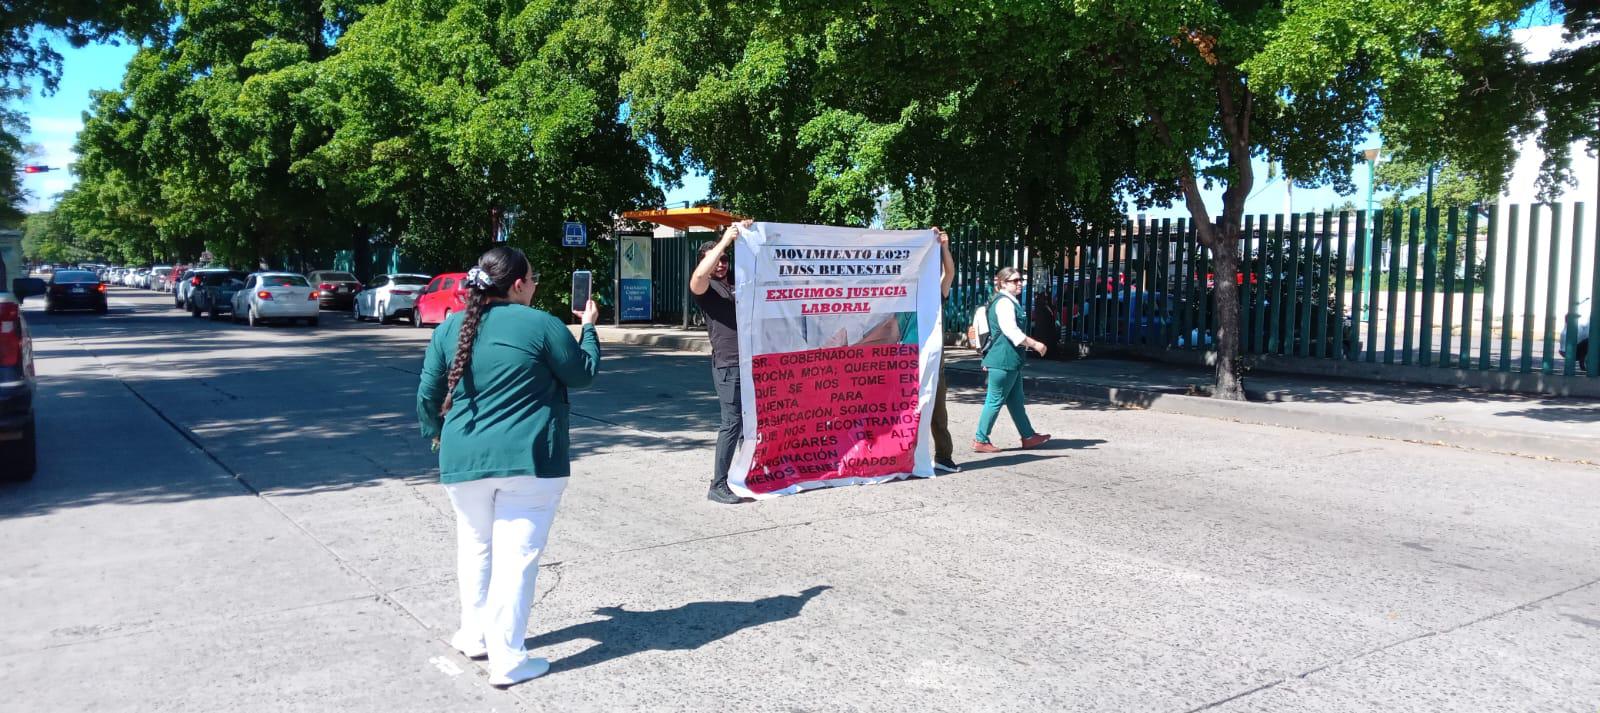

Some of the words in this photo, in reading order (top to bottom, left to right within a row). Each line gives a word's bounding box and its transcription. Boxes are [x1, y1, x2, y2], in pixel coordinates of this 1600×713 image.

[774, 249, 872, 260] MOVIMIENTO
[780, 264, 814, 274] IMSS
[820, 264, 902, 274] BIENESTAR
[766, 288, 843, 300] EXIGIMOS
[846, 286, 907, 299] JUSTICIA
[801, 302, 871, 314] LABORAL
[753, 358, 772, 368] SR.
[780, 349, 864, 366] GOBERNADOR
[872, 344, 919, 357] RUBÉN
[752, 370, 795, 384] ROCHA
[844, 360, 919, 373] QUEREMOS
[755, 386, 777, 399] QUE
[789, 383, 803, 393] SE
[815, 379, 839, 390] NOS
[851, 375, 886, 387] TOME
[900, 374, 919, 384] EN
[831, 391, 864, 403] PARA
[902, 387, 919, 398] LA
[840, 402, 887, 415] SOMOS
[892, 400, 918, 412] LOS
[784, 425, 806, 436] NOS
[816, 413, 921, 432] ENCONTRAMOS
[779, 436, 838, 452] LUGARES
[856, 430, 873, 440] DE
[891, 428, 915, 439] ALT
[747, 467, 795, 485] MENOS
